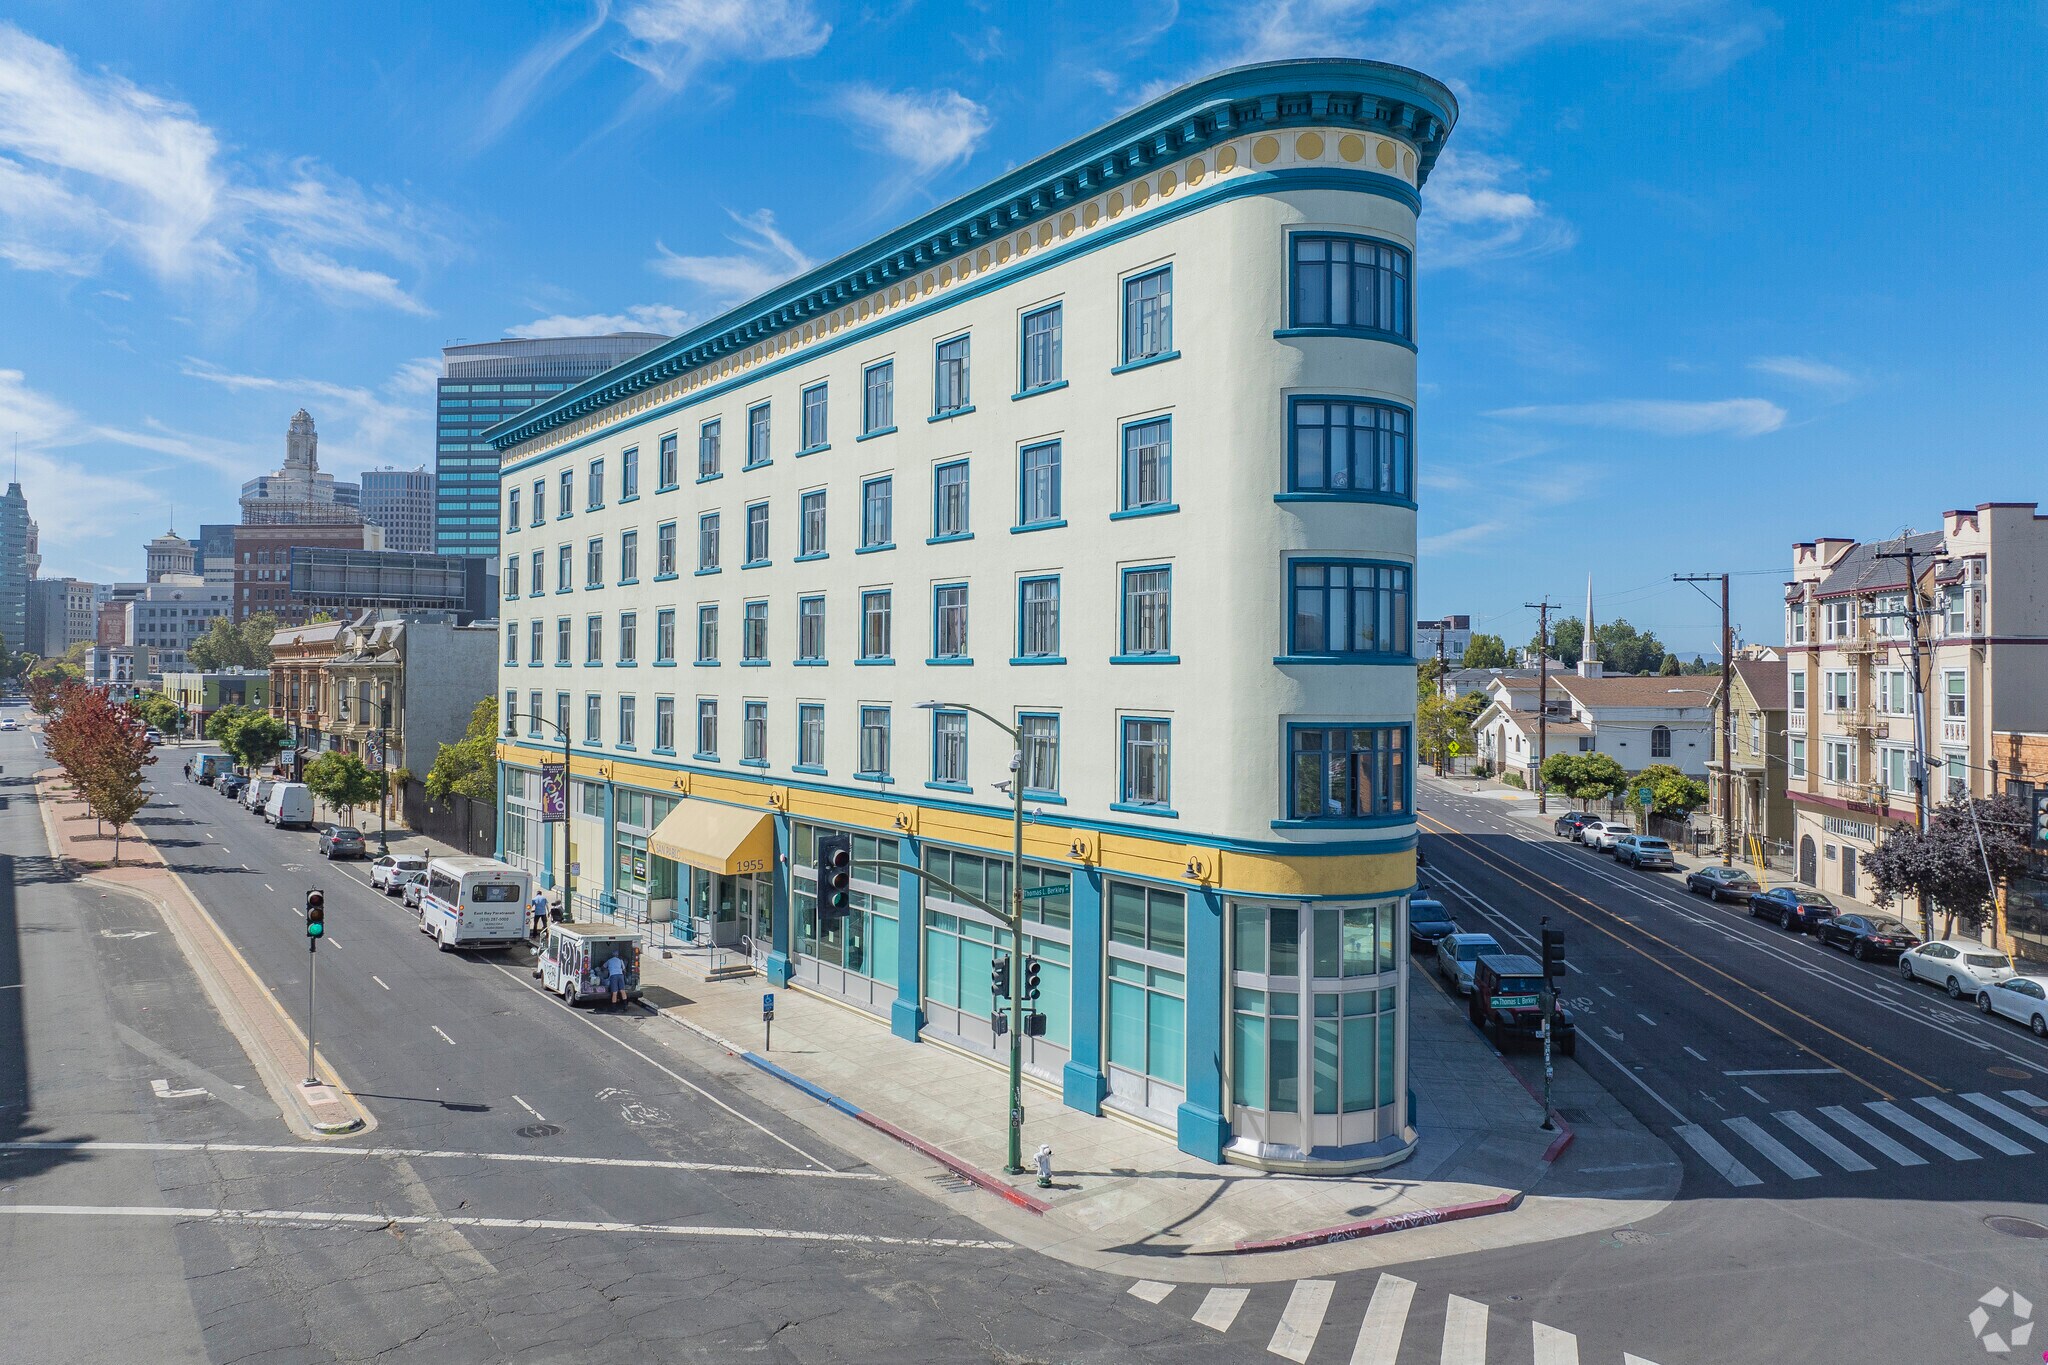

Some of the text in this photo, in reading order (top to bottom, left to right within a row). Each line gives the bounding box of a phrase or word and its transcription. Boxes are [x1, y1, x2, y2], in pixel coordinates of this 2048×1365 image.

[366, 739, 383, 763] KONO
[542, 776, 564, 811] KONO
[656, 844, 666, 856] SAN
[736, 860, 764, 872] 1955
[1048, 886, 1064, 894] Berkley
